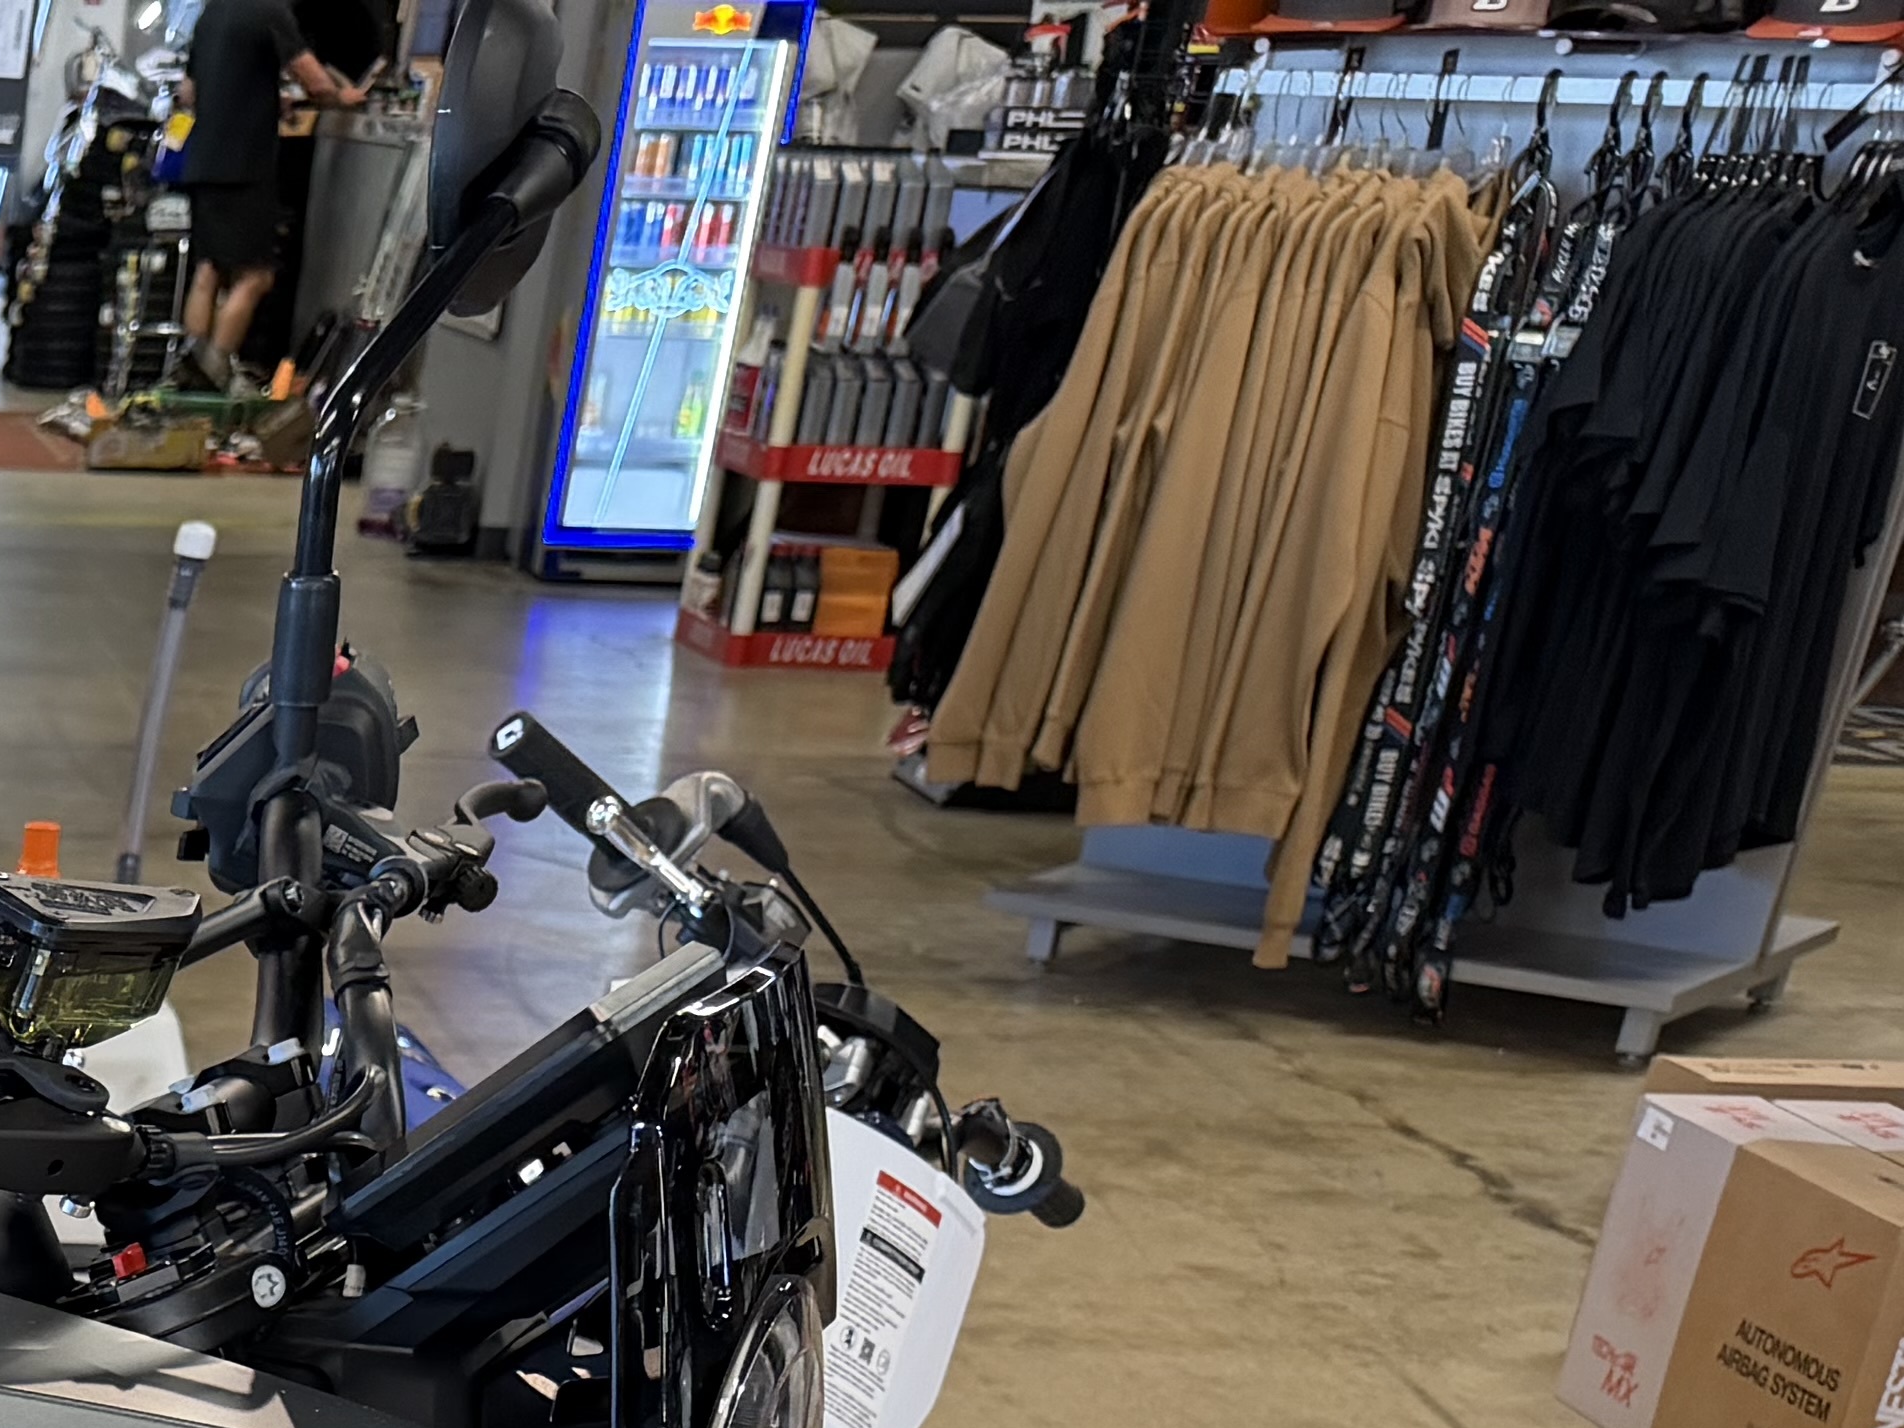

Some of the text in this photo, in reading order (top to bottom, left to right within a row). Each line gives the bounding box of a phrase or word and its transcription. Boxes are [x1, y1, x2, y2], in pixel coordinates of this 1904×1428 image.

[807, 449, 914, 479] LUCAS OIL
[768, 636, 875, 666] LUCAS OIL
[1735, 1318, 1842, 1393] AUTONOMOUS
[1717, 1344, 1832, 1424] AIRBAG SYSTEM
